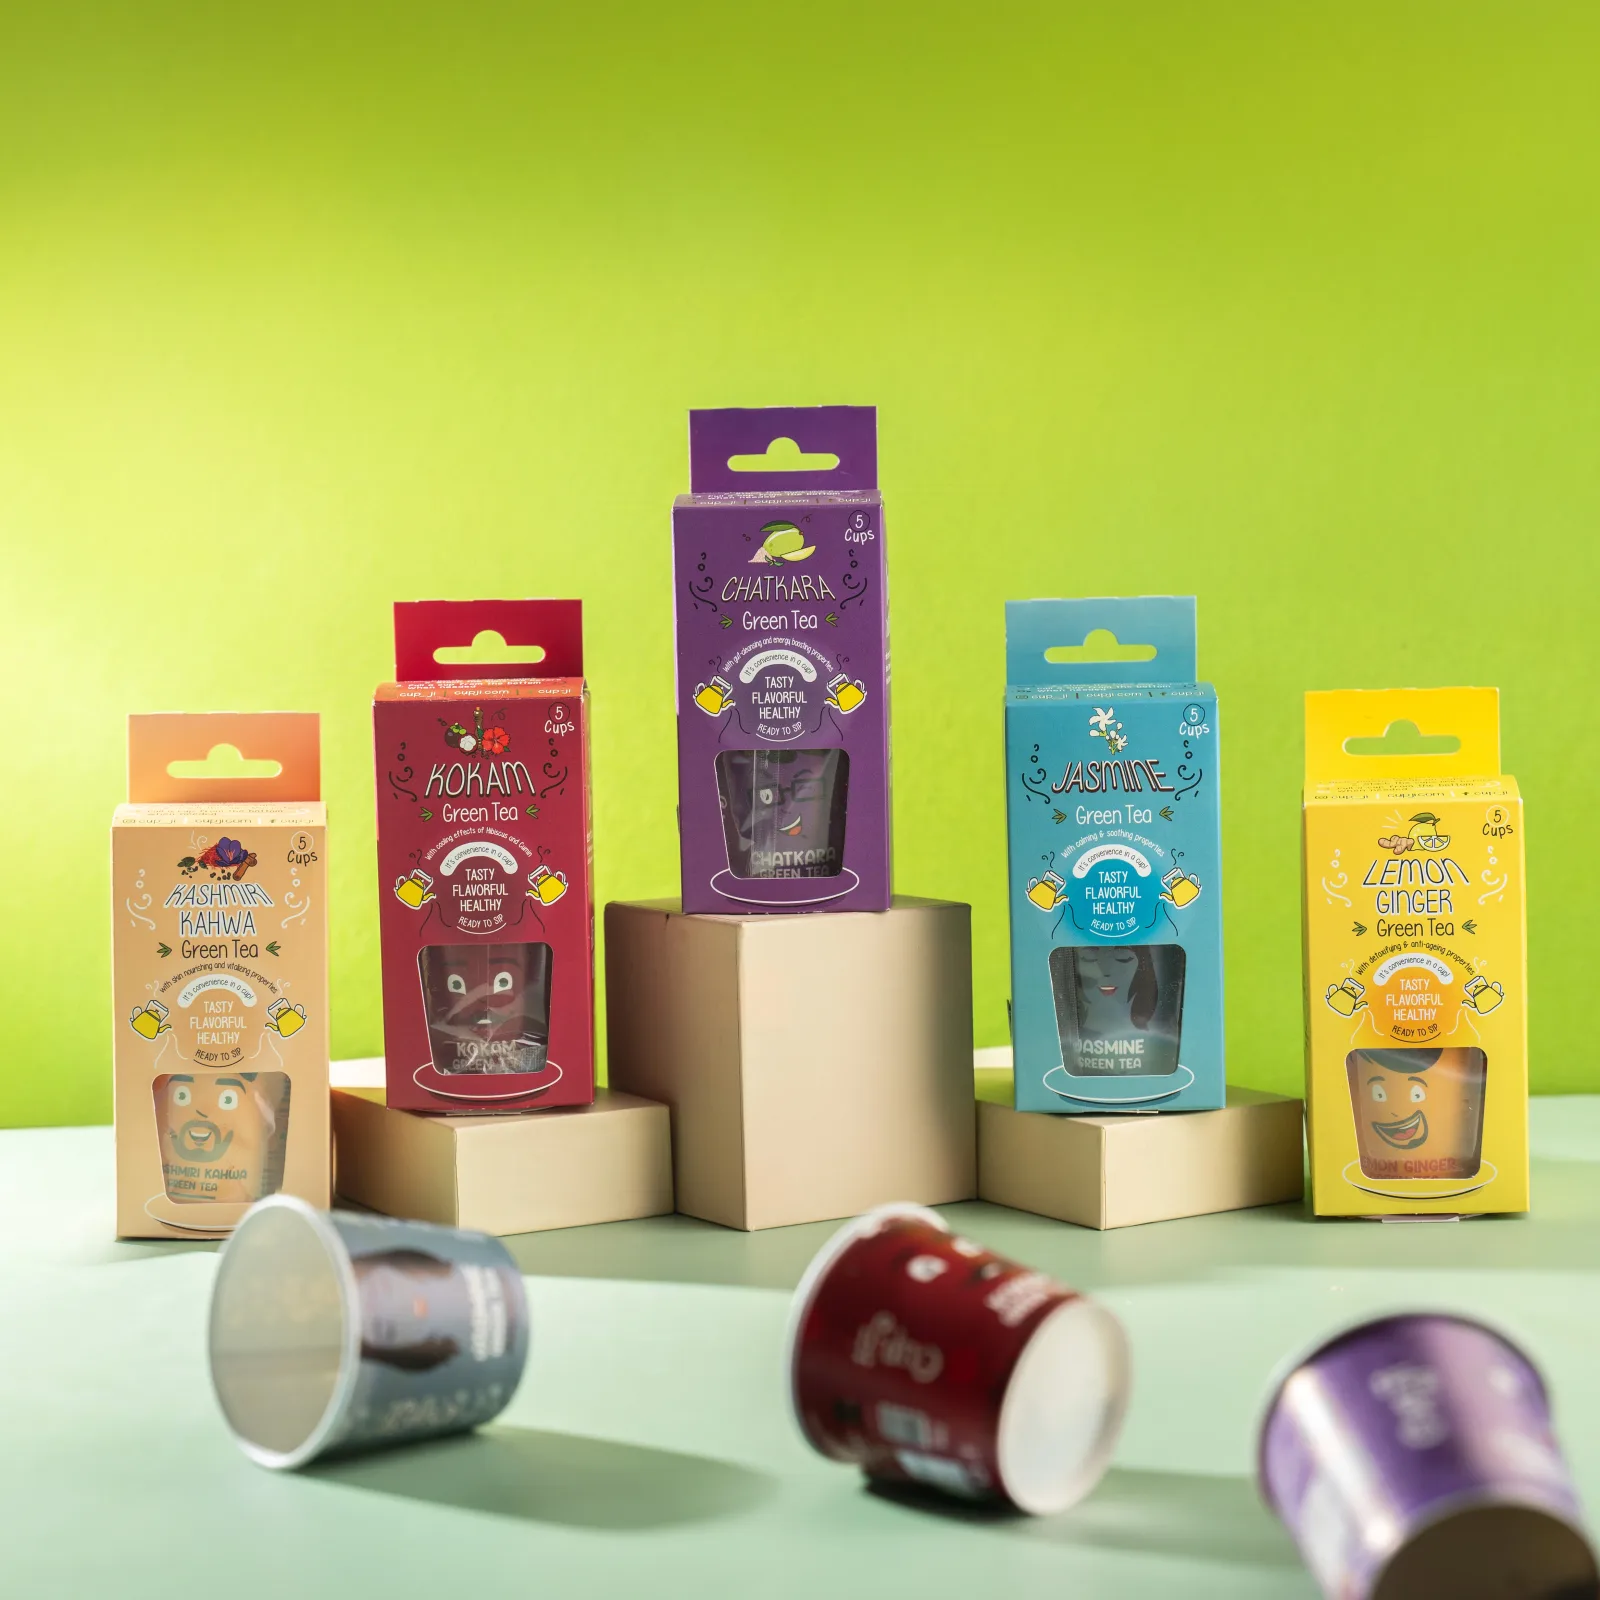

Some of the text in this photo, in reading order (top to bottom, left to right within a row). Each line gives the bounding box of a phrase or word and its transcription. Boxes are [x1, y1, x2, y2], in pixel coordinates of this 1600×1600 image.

[855, 515, 863, 528] 5
[845, 529, 875, 545] Cups
[721, 575, 836, 602] CHATKARA
[743, 610, 817, 630] Green Tea
[744, 665, 754, 676] It's
[754, 654, 788, 668] convenience
[790, 654, 796, 662] in
[802, 663, 813, 674] cup!
[765, 676, 794, 688] TASTY
[752, 692, 807, 704] FLAVORFUL
[555, 707, 563, 720] 5
[760, 706, 800, 719] HEALTHY
[1190, 708, 1198, 721] 5
[544, 721, 574, 736] Cups
[757, 722, 802, 735] READY TO SIP
[1179, 722, 1210, 739] Cups
[424, 761, 536, 798] KOKAM
[1051, 759, 1175, 793] JASMINE
[442, 802, 518, 822] Green Tea
[1076, 805, 1152, 824] Green Tea
[1493, 810, 1502, 823] 5
[1483, 823, 1514, 839] Cups
[298, 837, 307, 850] 5
[425, 847, 437, 860] With
[436, 835, 453, 850] cooling
[454, 828, 476, 839] effects
[486, 828, 508, 839] Hibiscus
[509, 835, 519, 845] and
[518, 842, 533, 857] Cumin
[1061, 845, 1075, 858] With
[1075, 833, 1097, 848] calming
[1107, 829, 1133, 840] soothing
[1134, 833, 1165, 857] properties
[288, 851, 318, 867] Cups
[445, 857, 455, 869] It's
[454, 846, 489, 861] convenience
[502, 856, 514, 867] cup!
[752, 847, 836, 866] CHATKARA
[1078, 861, 1088, 872] It's
[1088, 849, 1122, 863] convenience
[1136, 858, 1148, 870] cup!
[465, 869, 495, 881] TASTY
[760, 865, 829, 878] GREEN TEA
[1099, 871, 1128, 883] TASTY
[1362, 858, 1470, 888] LEMON
[163, 883, 275, 908] KASHMIRI
[453, 884, 508, 896] FLAVORFUL
[1085, 887, 1141, 899] FLAVORFUL
[460, 899, 502, 912] HEALTHY
[1093, 902, 1135, 914] HEALTHY
[1376, 889, 1454, 915] GINGER
[179, 909, 257, 937] KAHWA
[458, 914, 503, 928] READY TO SIP
[1091, 919, 1113, 931] READY
[1127, 917, 1136, 927] SIP
[1377, 918, 1454, 936] Green Tea
[182, 940, 258, 958] Green Tea
[1356, 963, 1369, 976] With
[1369, 943, 1402, 964] detoxifying
[1411, 940, 1446, 955] anti-ageing
[1447, 950, 1475, 976] properties
[1379, 967, 1389, 979] It's
[1388, 957, 1424, 971] convenience
[1438, 967, 1450, 978] cup!
[172, 971, 183, 983] skin
[184, 963, 212, 977] nourishing
[214, 961, 225, 969] and
[227, 963, 250, 976] vitalizing
[251, 970, 278, 994] properties
[1400, 979, 1430, 990] TASTY
[183, 991, 193, 1001] It's
[193, 979, 228, 992] convenience
[241, 989, 254, 1000] cup!
[204, 1001, 233, 1013] TASTY
[1386, 994, 1443, 1006] FLAVORFUL
[1394, 1009, 1436, 1021] HEALTHY
[190, 1017, 247, 1029] FLAVORFUL
[1392, 1025, 1414, 1037] READY
[1428, 1024, 1437, 1034] SIP
[197, 1032, 239, 1044] HEALTHY
[195, 1048, 241, 1061] READY TO SIP
[457, 1040, 516, 1057] KOKAM
[1119, 1058, 1141, 1069] TEA
[163, 1164, 247, 1179] SHMIRI KAHWA
[1363, 1157, 1456, 1173] MON GINGER
[200, 1182, 217, 1191] TEA
